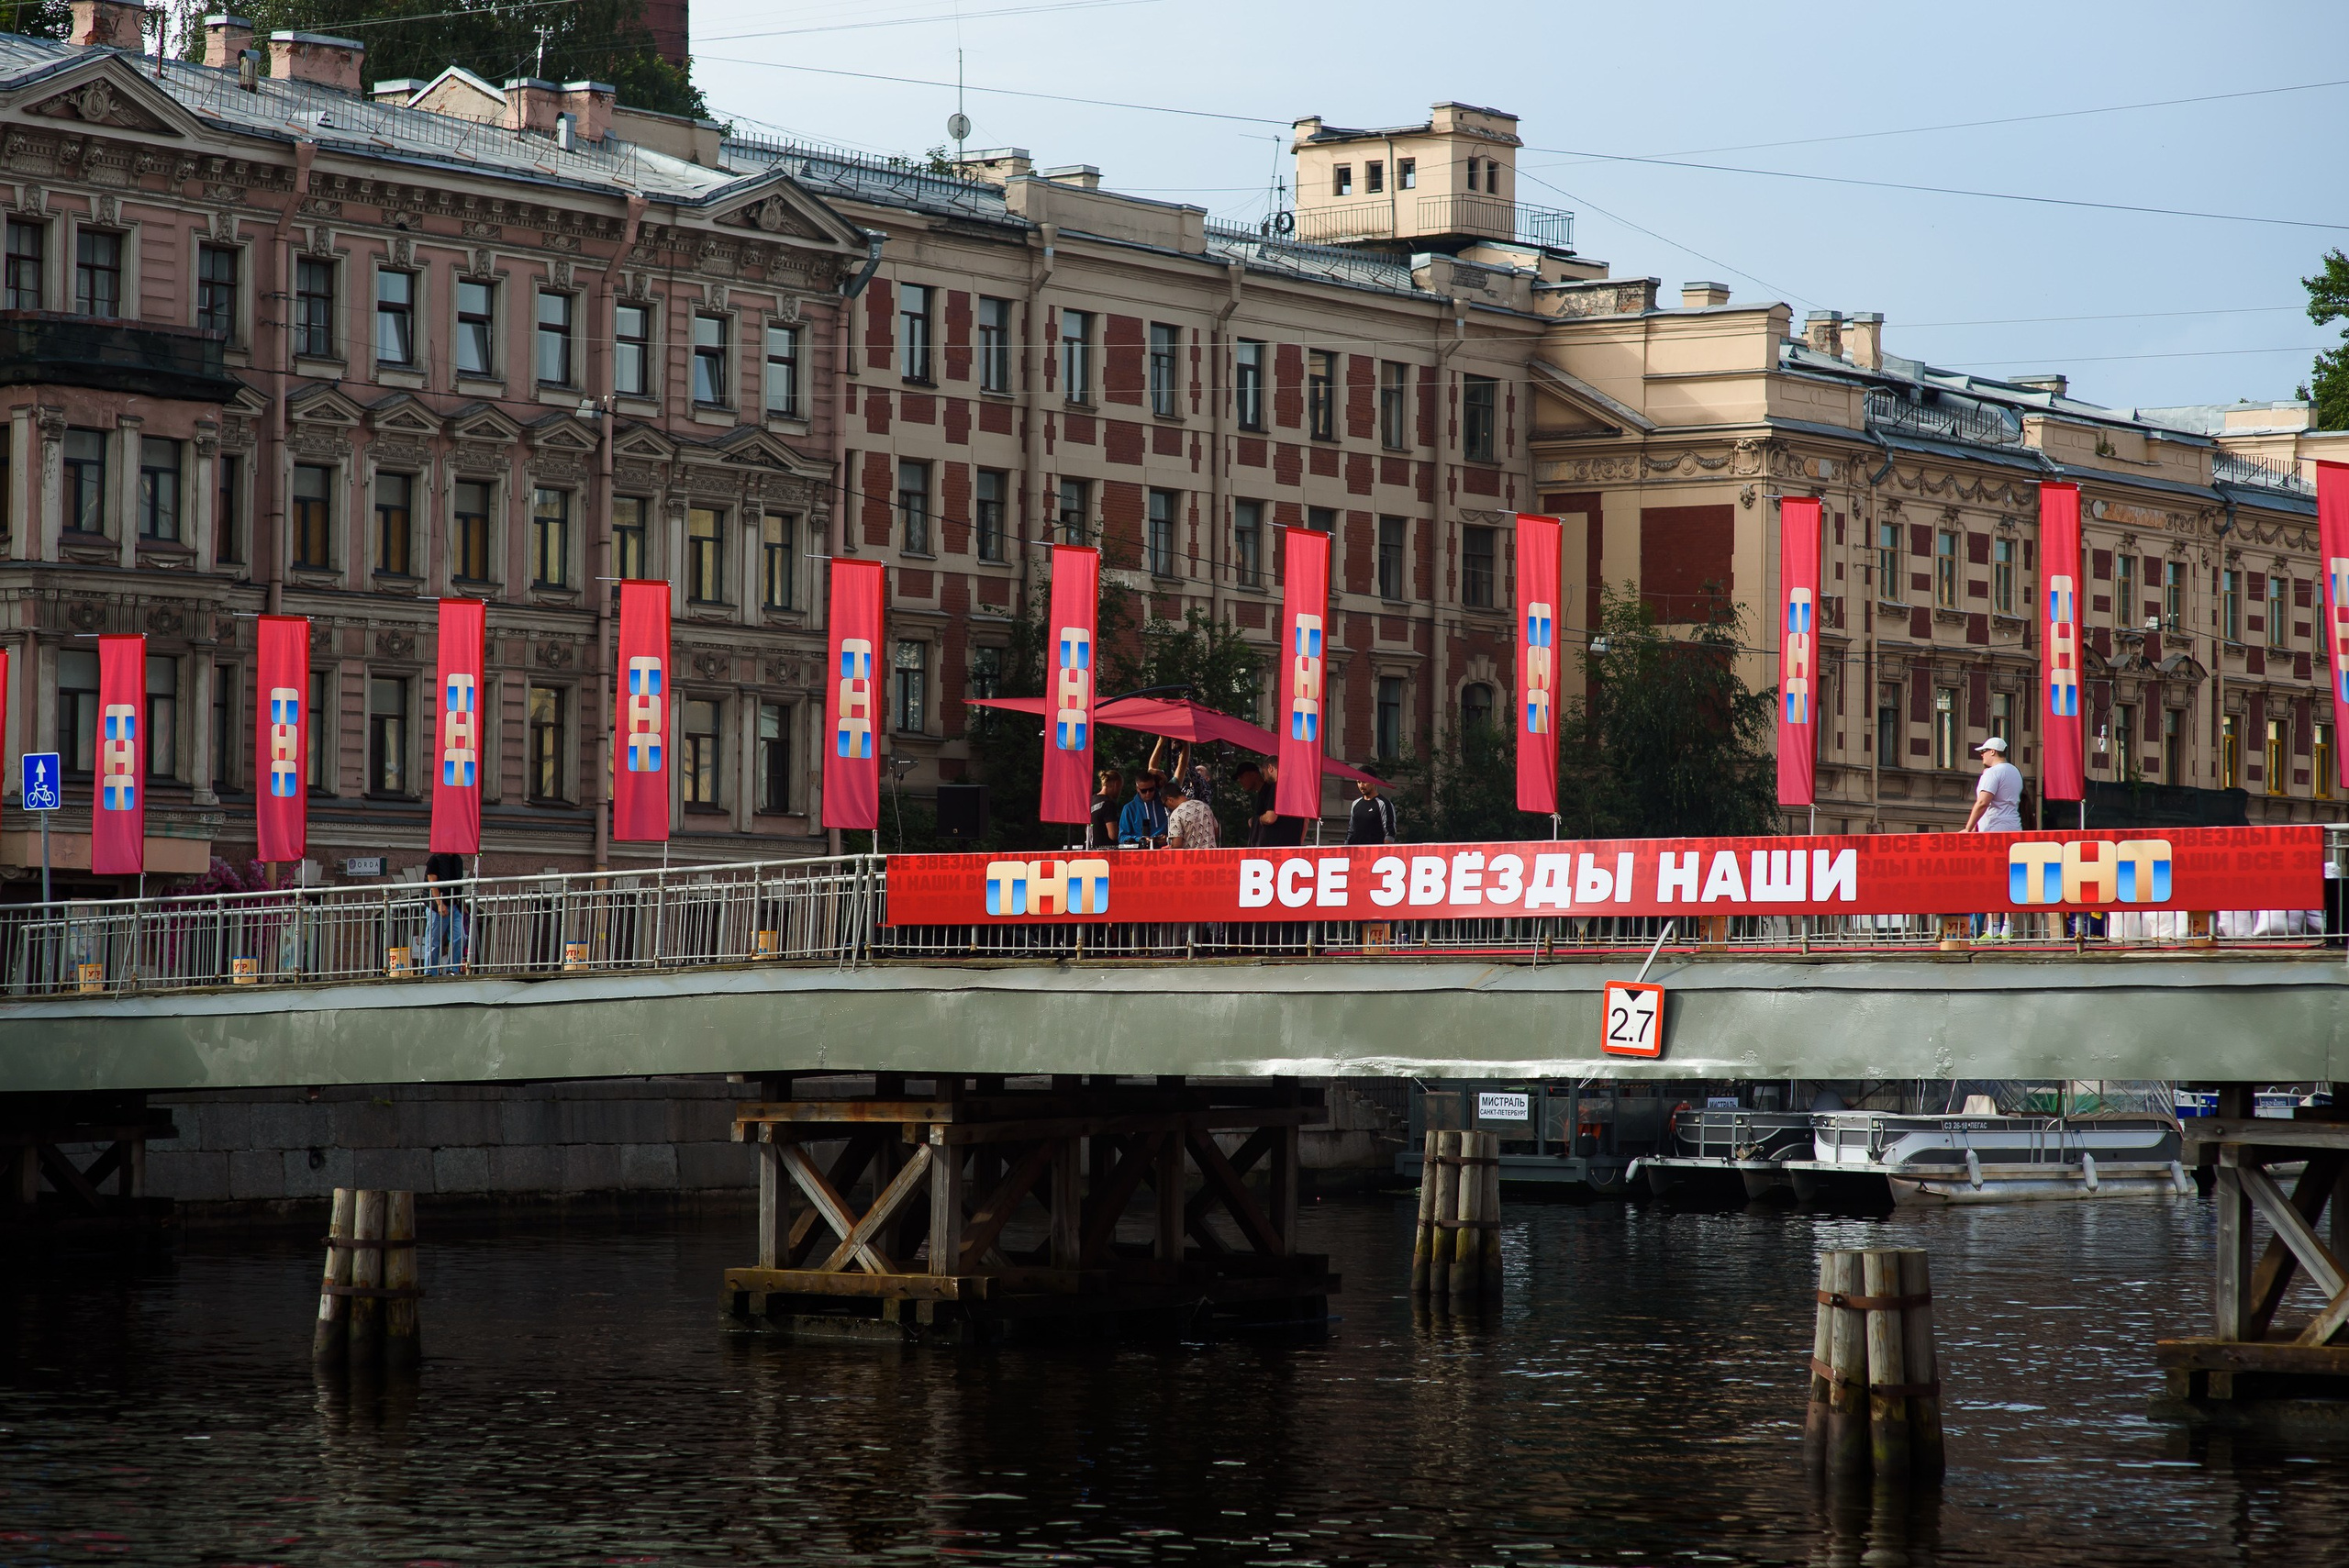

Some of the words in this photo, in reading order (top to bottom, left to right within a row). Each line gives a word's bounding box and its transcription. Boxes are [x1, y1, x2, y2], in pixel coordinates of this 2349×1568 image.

[838, 639, 872, 759] ТНТ
[1057, 627, 1089, 751] ТНТ
[1292, 613, 1322, 742] ТНТ
[1527, 602, 1552, 734] ТНТ
[1787, 587, 1811, 724] ТНТ
[2051, 575, 2077, 716] ТНТ
[104, 705, 135, 810] ТНТ
[271, 687, 298, 796] ТНТ
[443, 673, 475, 786] ТНТ
[628, 656, 661, 772] ТНТ
[986, 859, 1109, 916] ТНТ
[1239, 858, 1350, 907] ВСЕ
[1370, 851, 1635, 909] ЗВЁЗДЫ
[1657, 850, 1857, 903] НАШИ
[1917, 857, 1987, 877] НАШИ
[2009, 839, 2172, 905] ТНТ
[1609, 1007, 1654, 1042] 2.7
[1479, 1108, 1527, 1117] САНКТ-ПЕТЕРБУРГ
[1481, 1095, 1526, 1107] МИСТРАЛЬ
